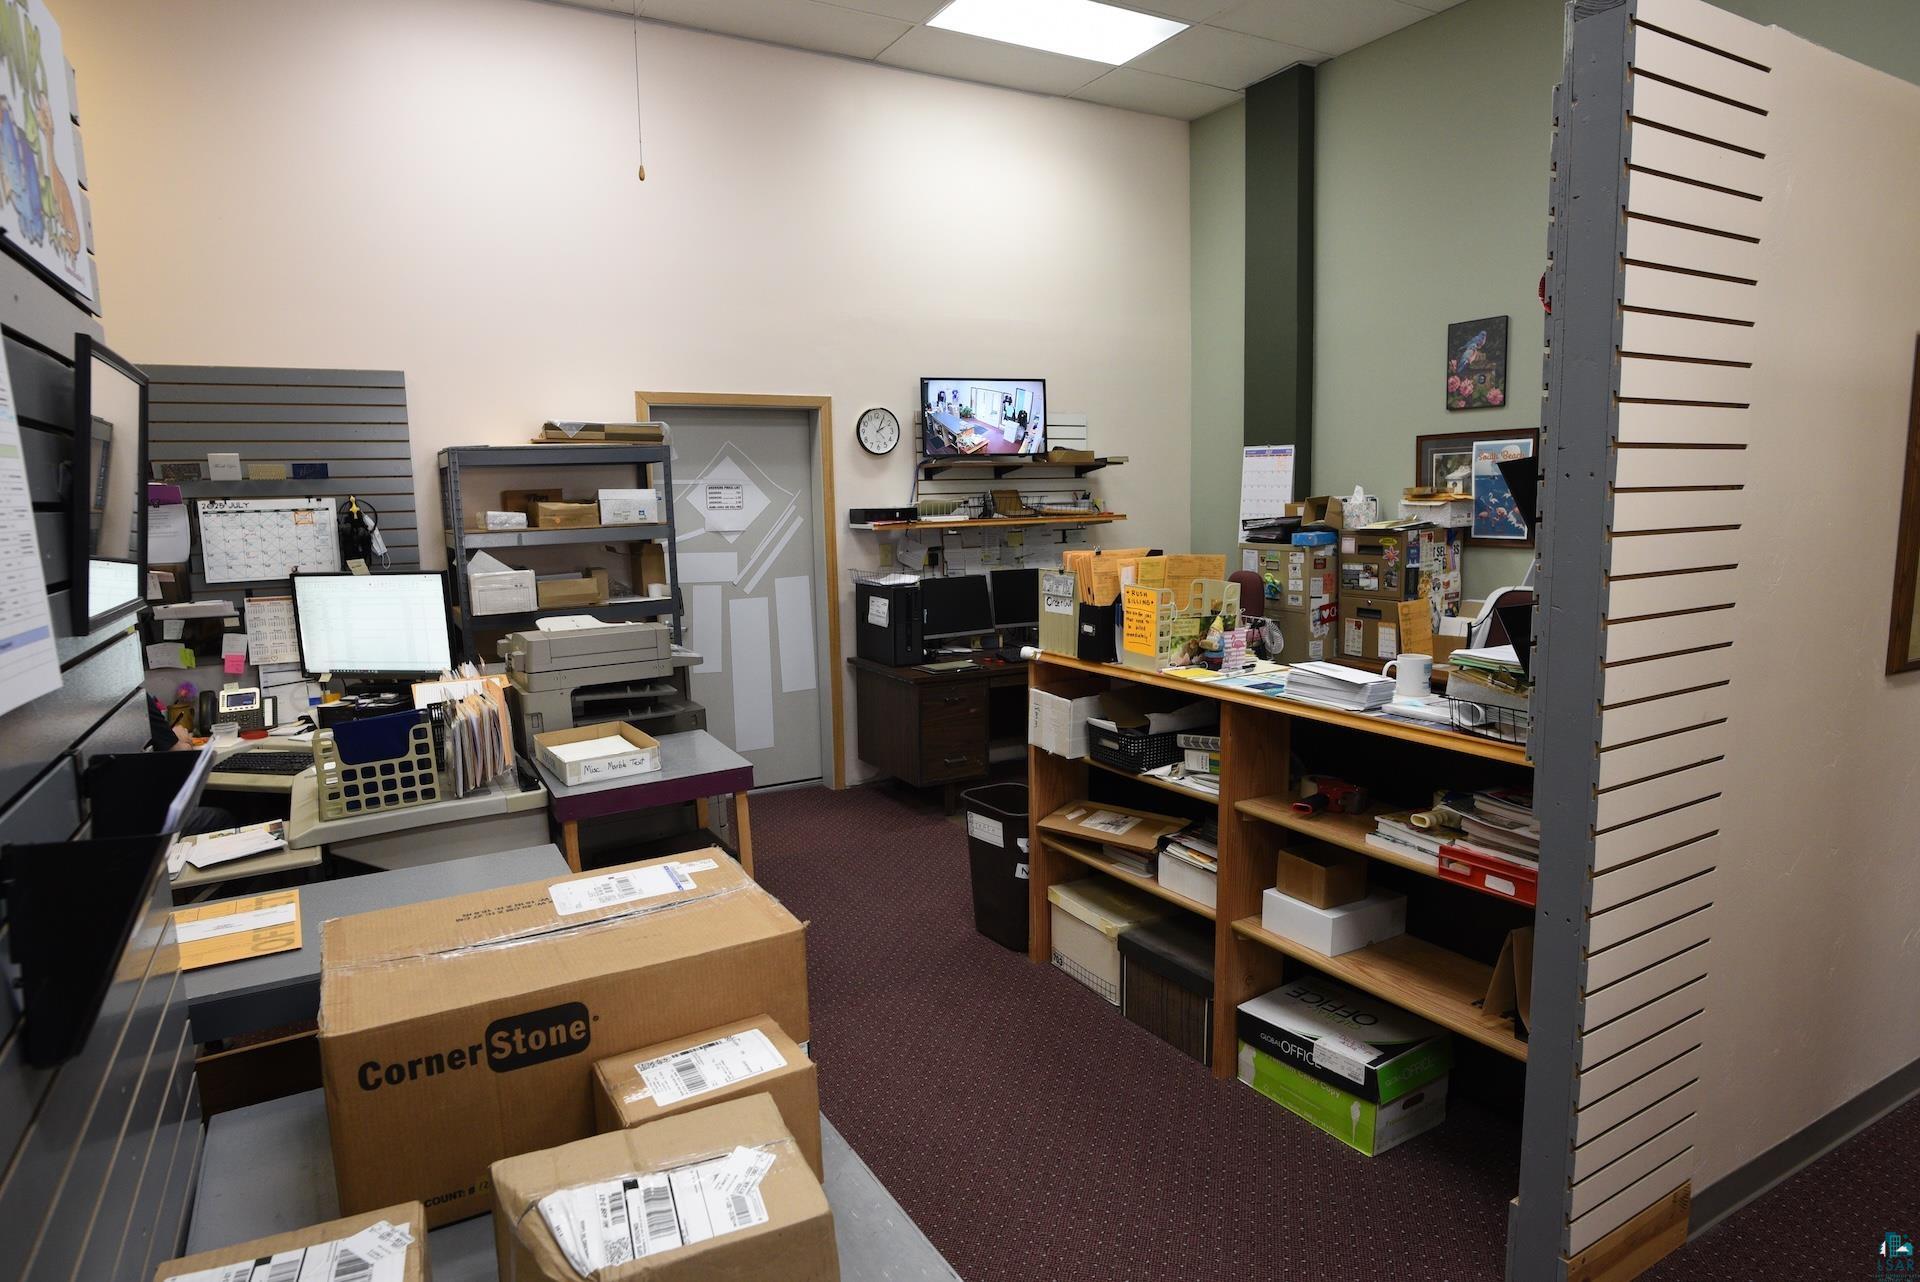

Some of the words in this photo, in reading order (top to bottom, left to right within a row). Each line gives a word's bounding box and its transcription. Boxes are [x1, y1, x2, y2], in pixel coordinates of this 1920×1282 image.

[1053, 953, 1064, 967] 703
[1285, 987, 1379, 1027] OFFICE
[1259, 1032, 1282, 1048] GLOBAL
